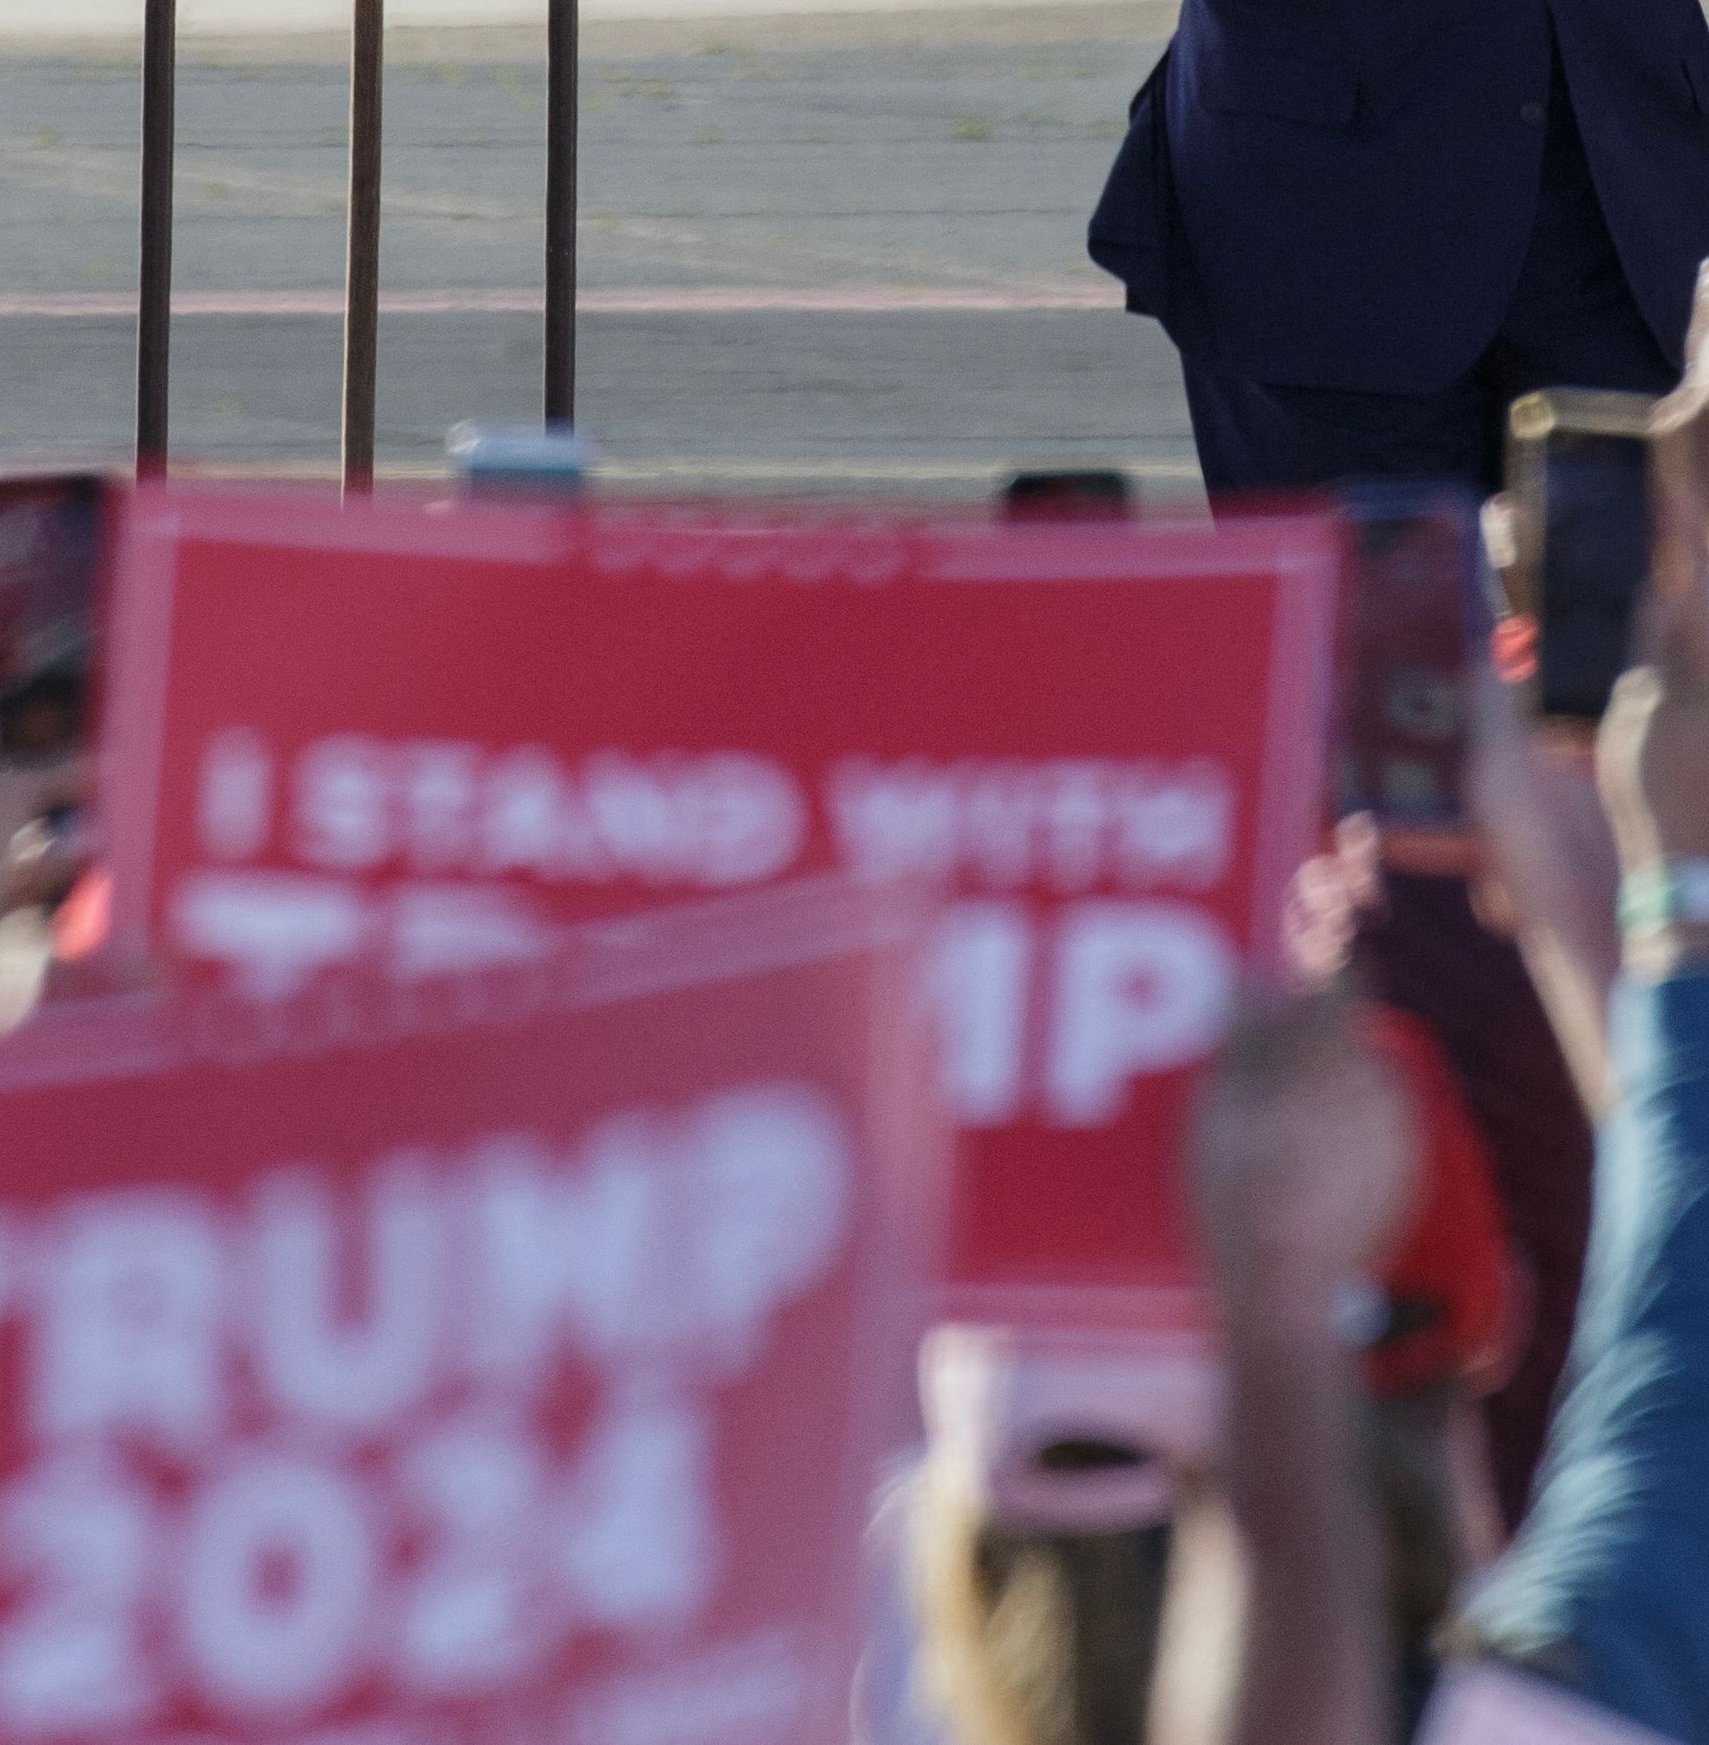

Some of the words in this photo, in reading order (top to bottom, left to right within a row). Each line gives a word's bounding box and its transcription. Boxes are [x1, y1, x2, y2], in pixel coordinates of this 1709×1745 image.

[199, 723, 271, 859] I
[295, 729, 807, 889] STAND
[827, 755, 1235, 892] WITH
